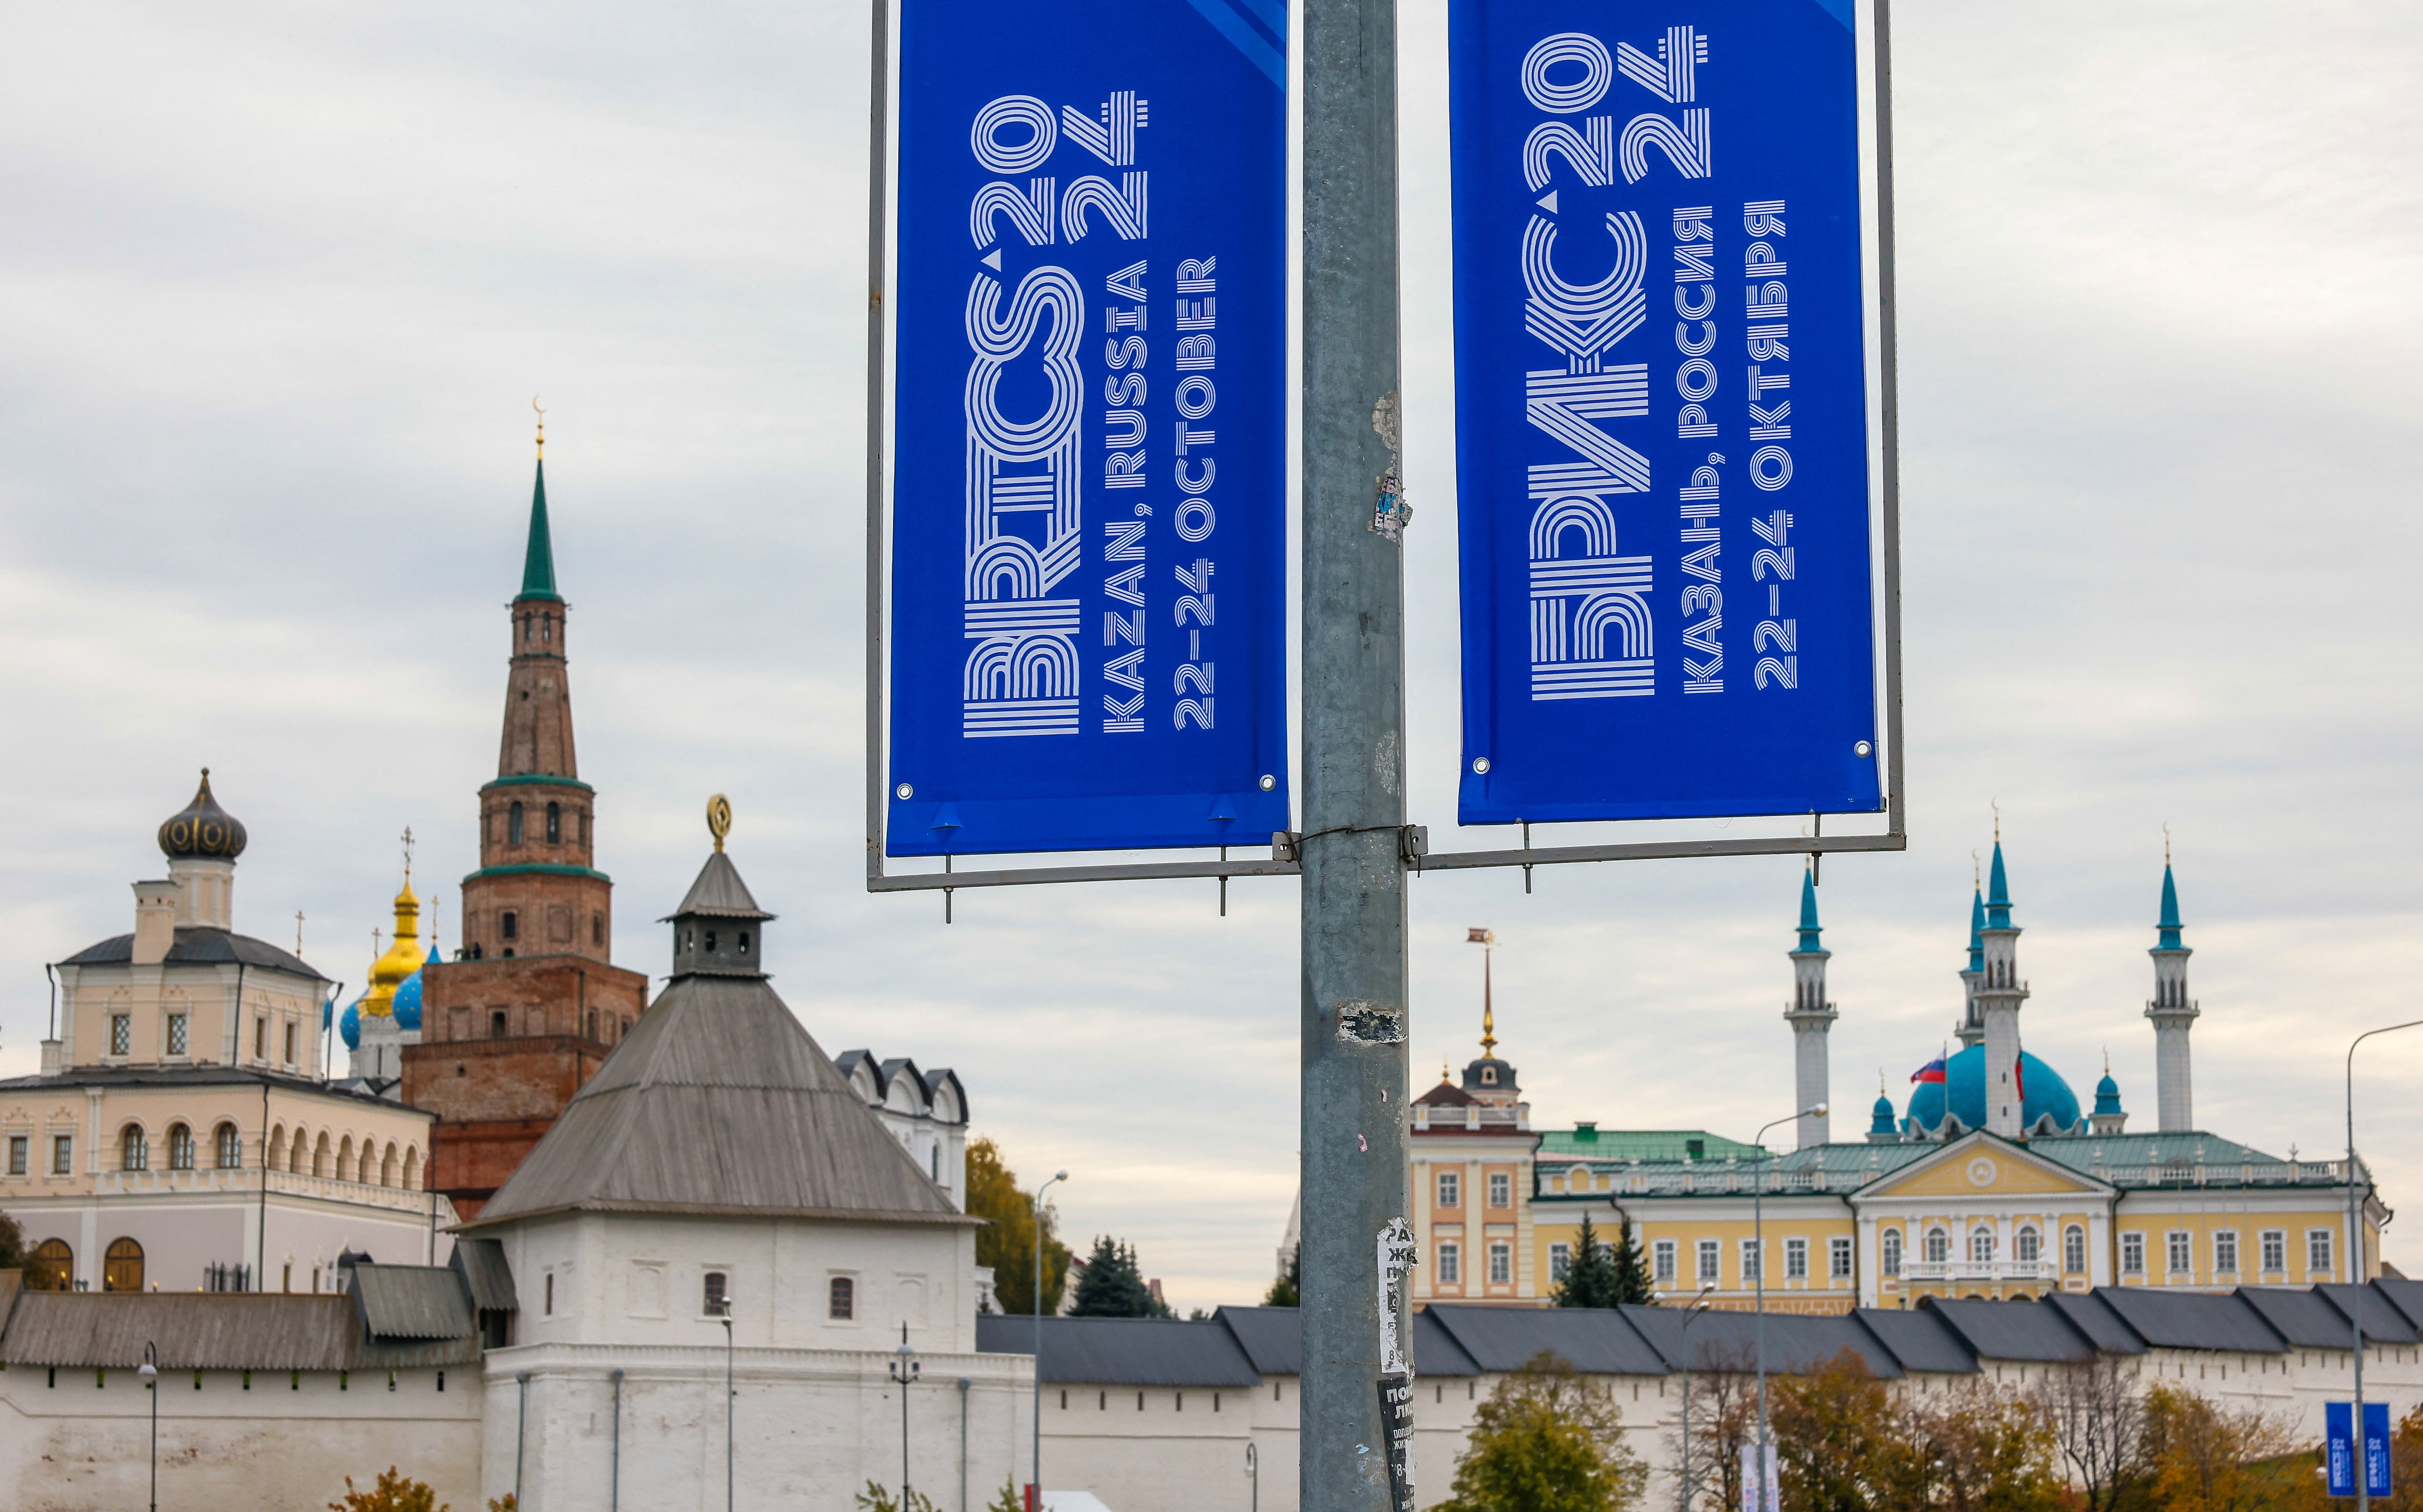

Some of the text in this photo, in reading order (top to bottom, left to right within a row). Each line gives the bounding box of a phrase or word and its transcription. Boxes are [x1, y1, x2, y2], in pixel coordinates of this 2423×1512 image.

[1061, 90, 1148, 245] 24
[1618, 25, 1711, 185] 24
[963, 94, 1085, 738] BRICS 20
[1103, 259, 1152, 733] KAZAN, RUSSIA
[1175, 255, 1216, 542] OCTOBER
[1522, 32, 1655, 701] БРИКС 20
[1673, 206, 1726, 693] КАЗАНЬ, РОССИЯ
[1744, 200, 1794, 491] ОКТЯБРЯ
